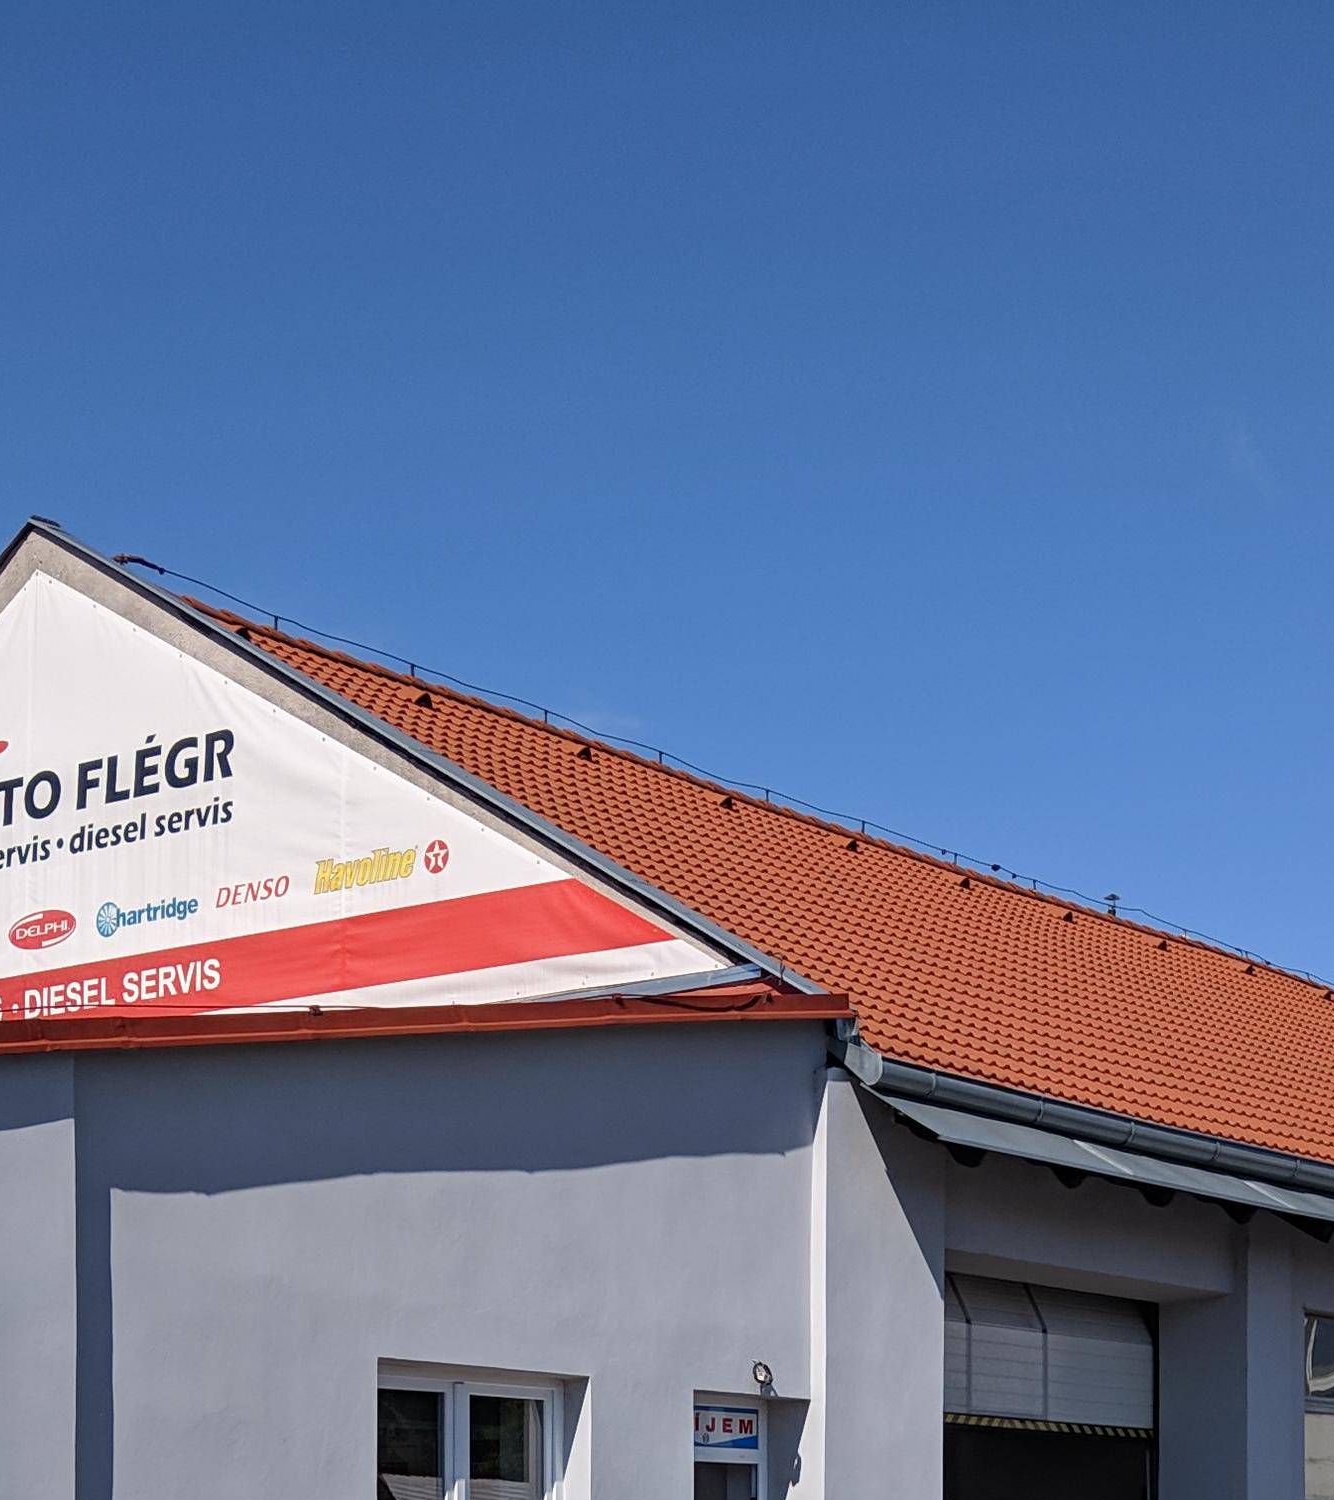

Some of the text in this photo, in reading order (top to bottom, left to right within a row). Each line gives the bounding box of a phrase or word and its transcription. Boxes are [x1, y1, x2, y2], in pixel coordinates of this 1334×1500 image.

[75, 729, 235, 810] FLÉGR
[69, 812, 146, 855] diesel
[154, 797, 233, 837] servis
[216, 875, 290, 908] DENSO
[314, 847, 416, 895] Havoline
[15, 918, 68, 941] DELPHI
[116, 896, 199, 928] hartridge
[24, 977, 116, 1020] DIESEL
[122, 959, 221, 1003] SERVIS
